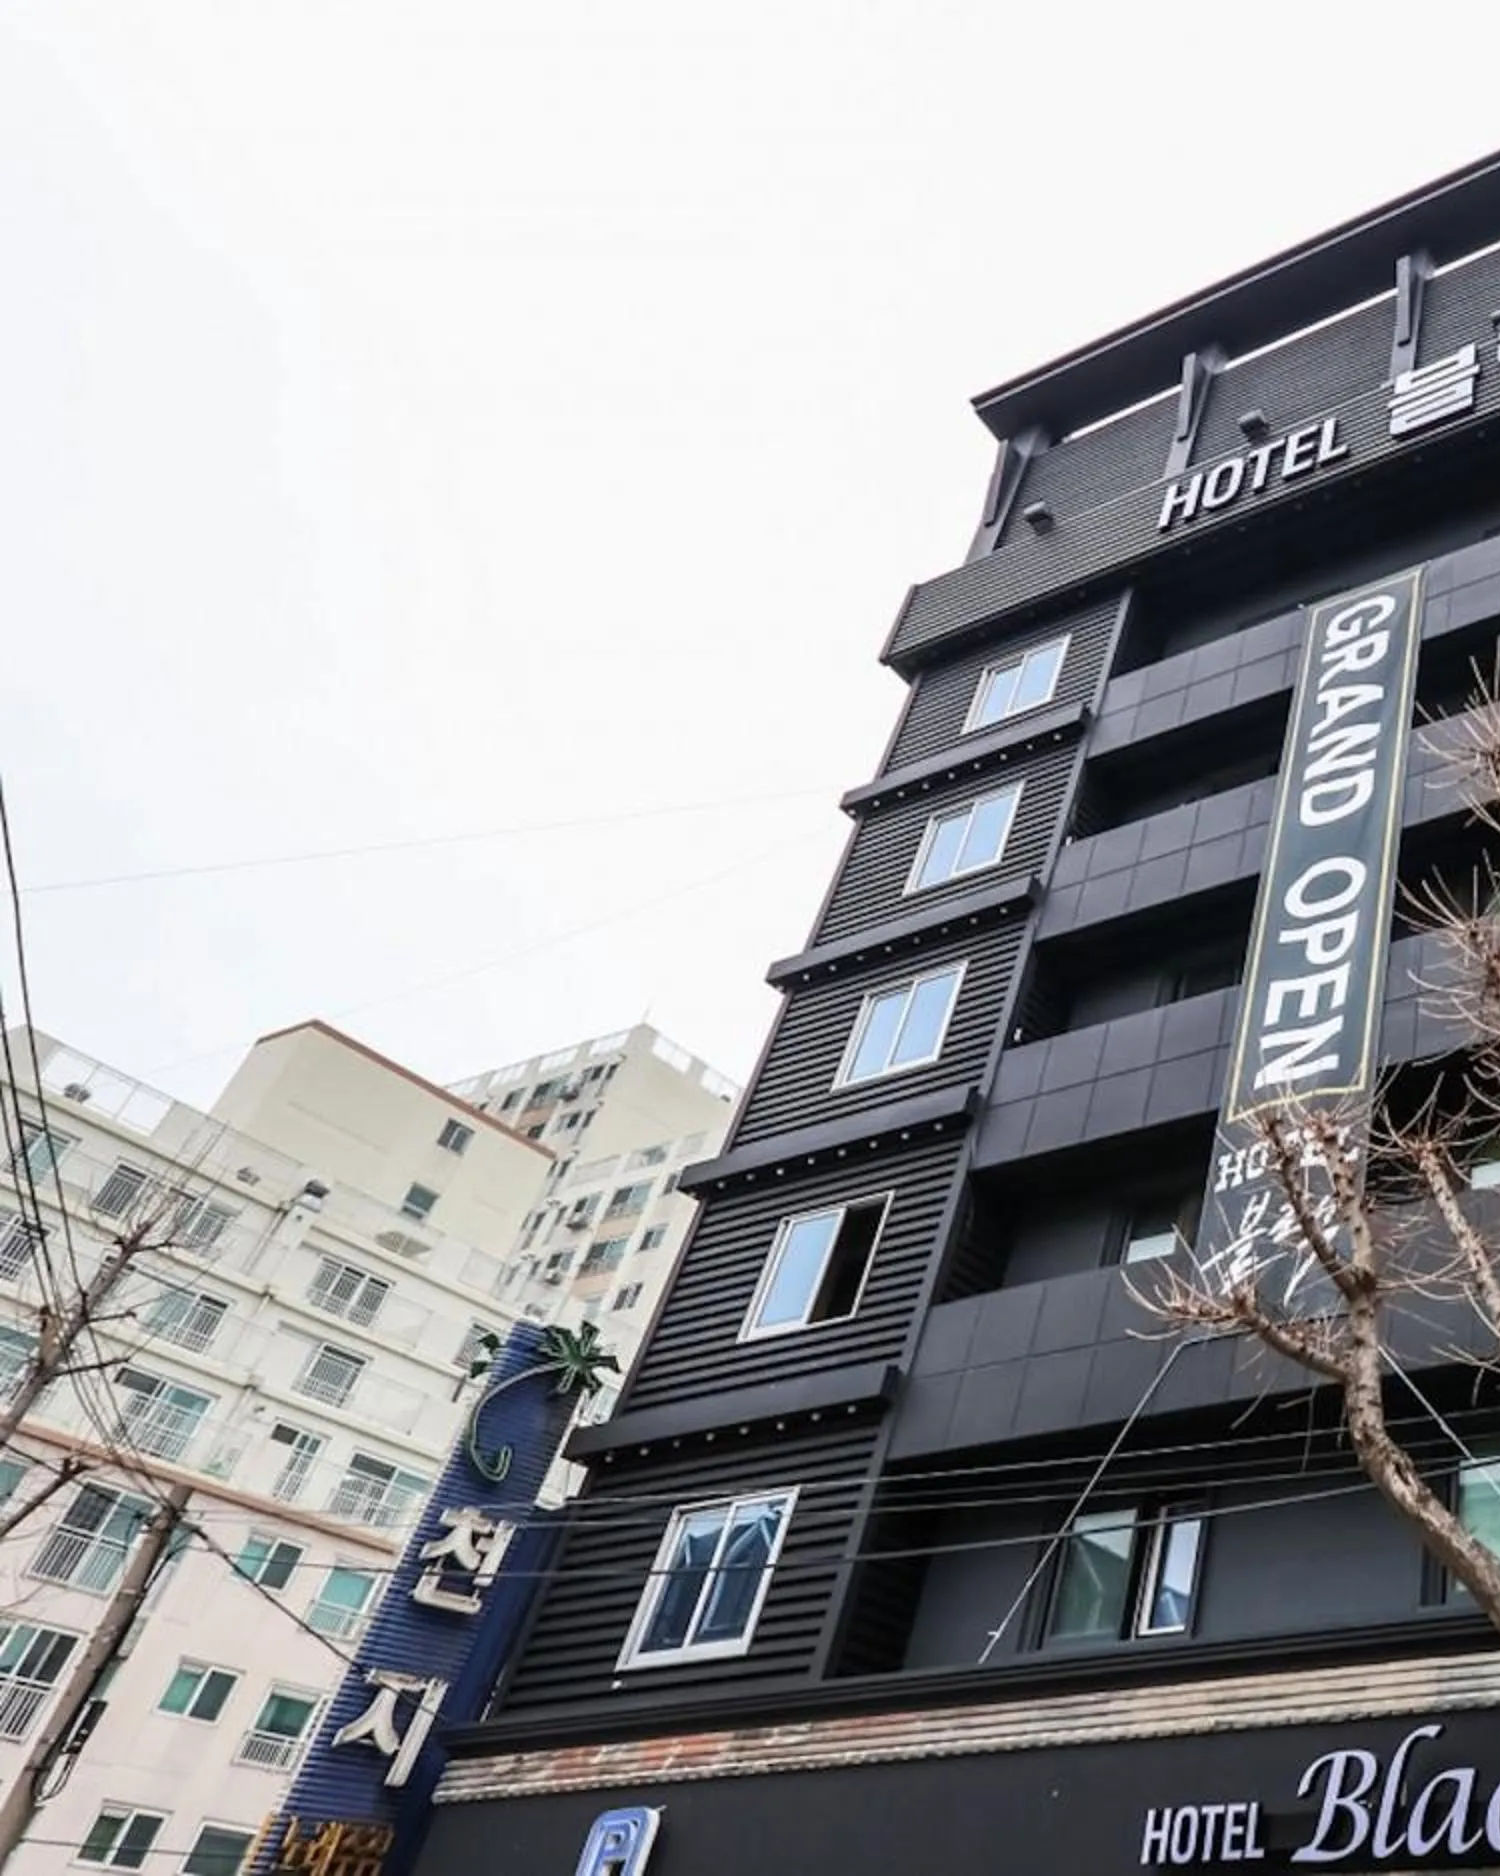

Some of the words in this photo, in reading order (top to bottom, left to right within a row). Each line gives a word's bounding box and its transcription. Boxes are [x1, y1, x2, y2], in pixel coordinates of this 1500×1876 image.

[1158, 418, 1348, 528] HOTEL
[1300, 595, 1396, 826] GRAND
[1254, 857, 1367, 1090] OPEN
[1139, 1800, 1266, 1866] HOTEL
